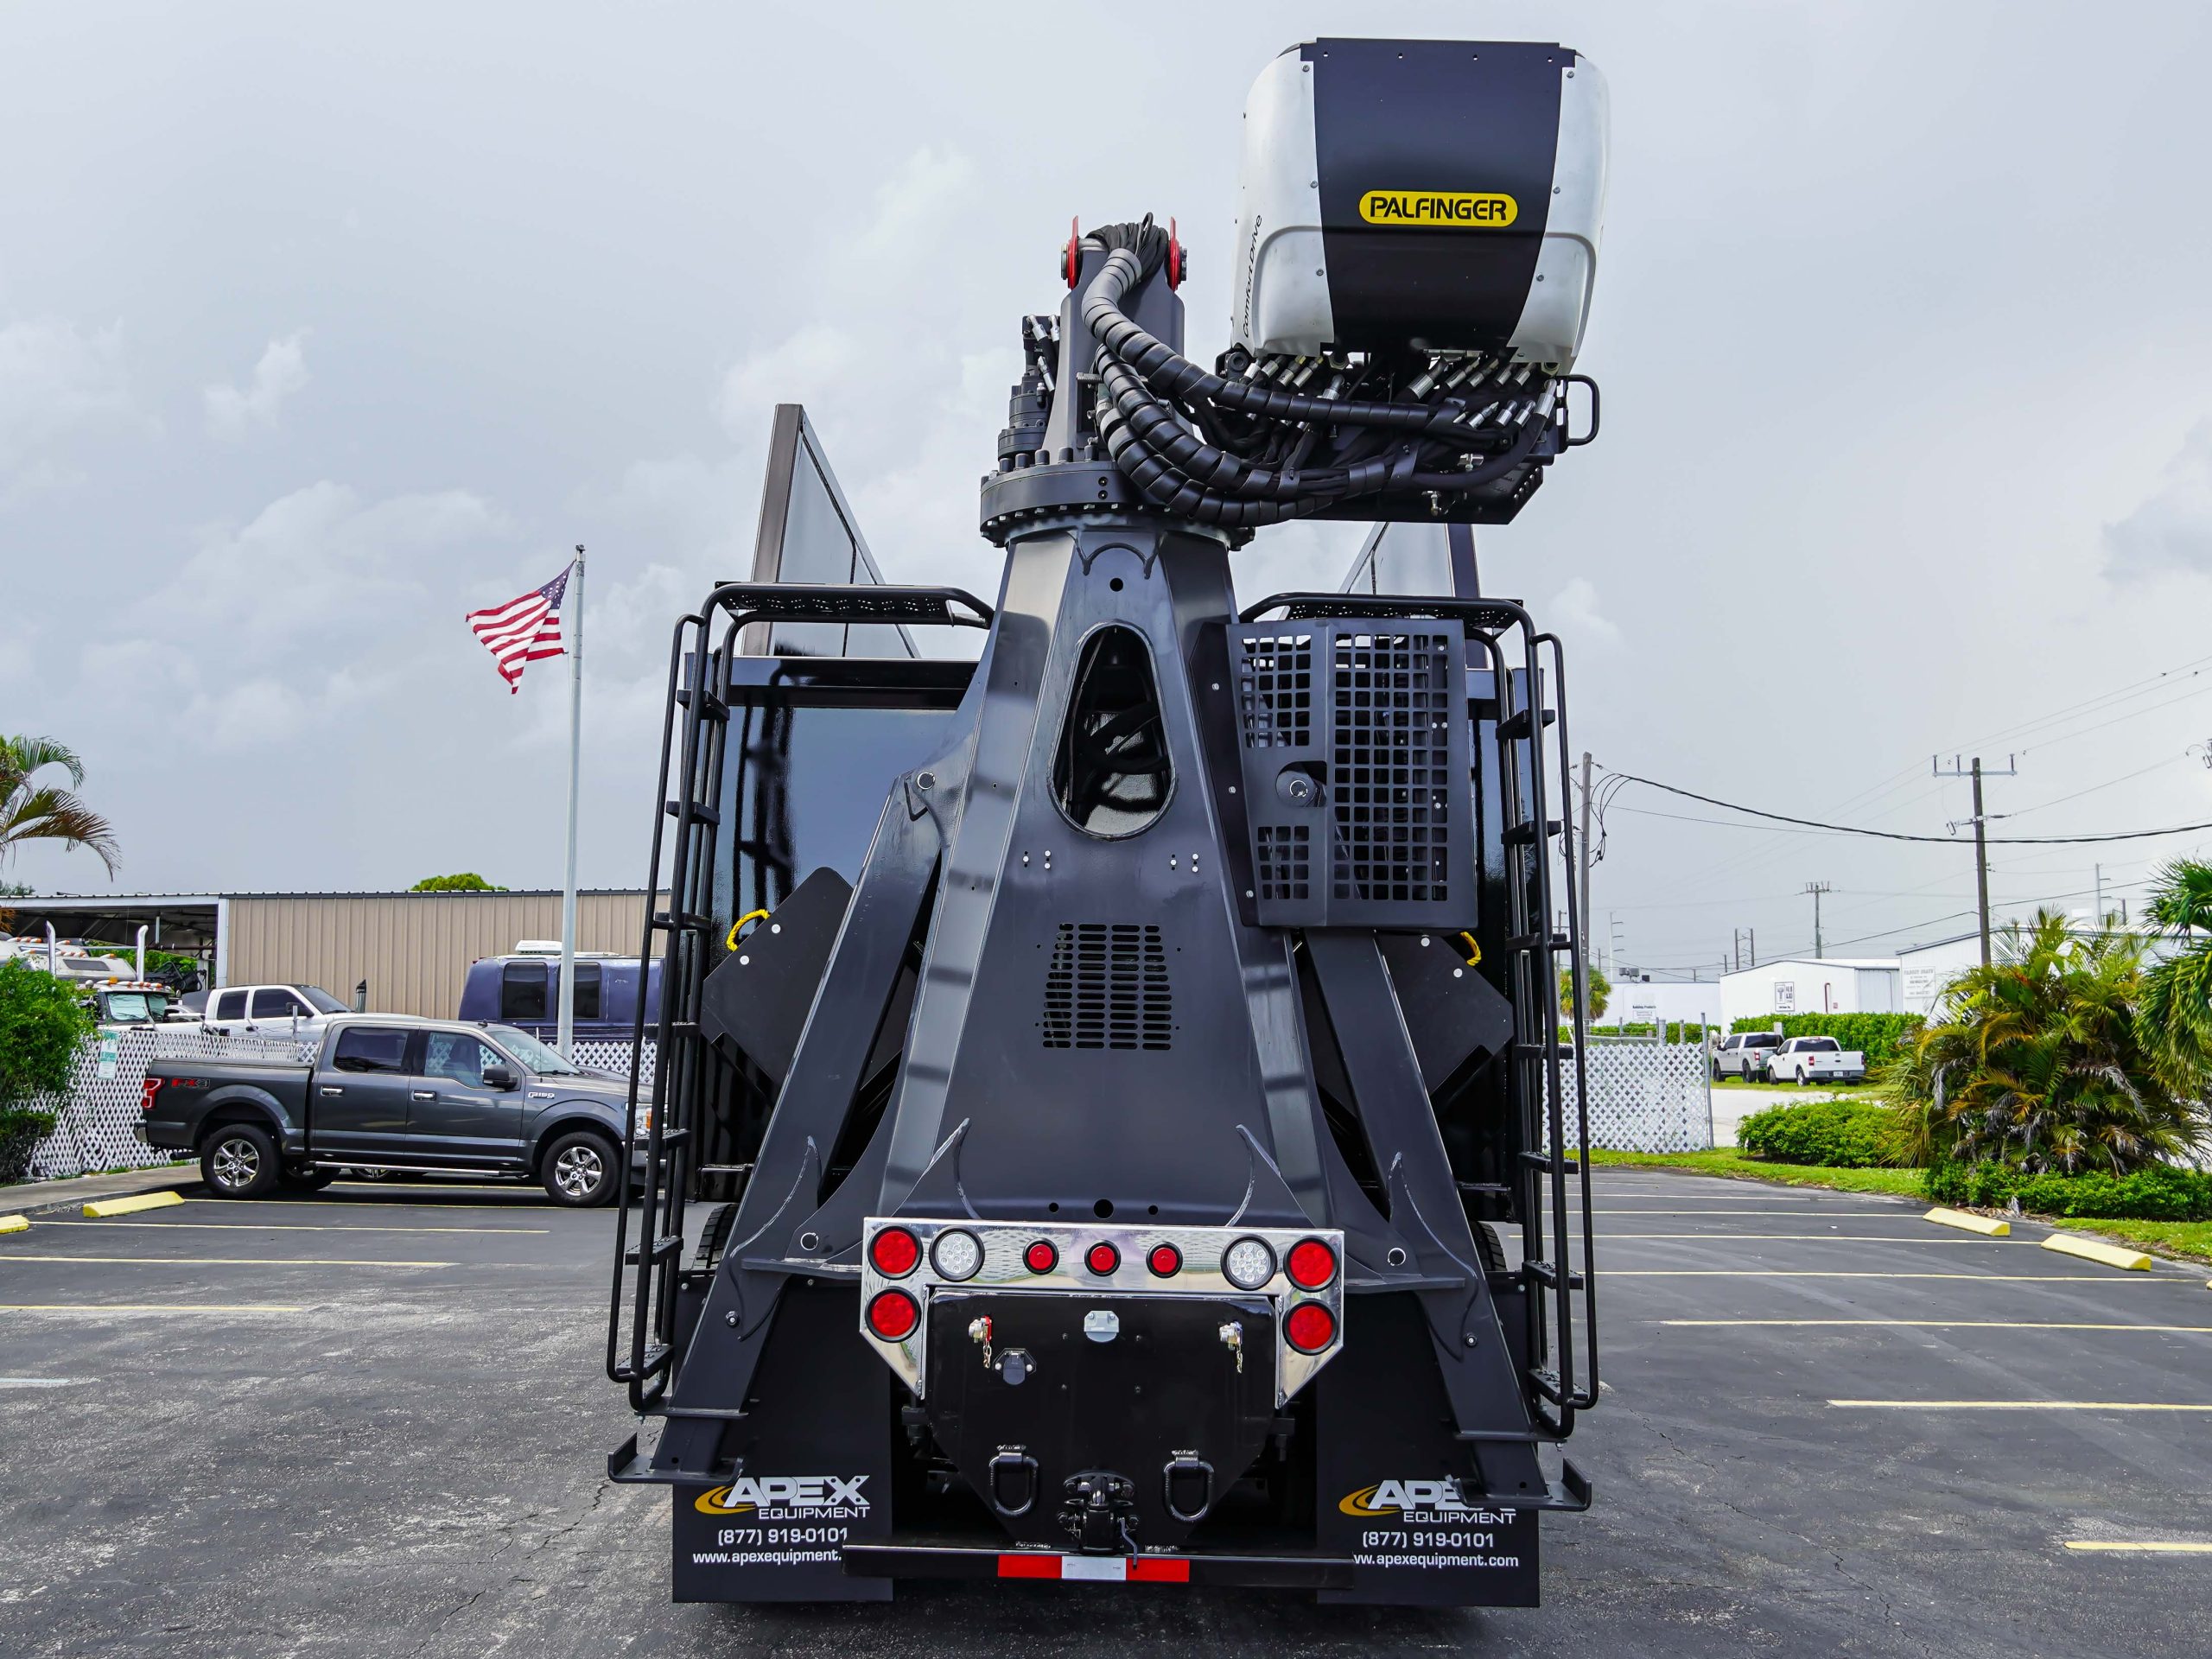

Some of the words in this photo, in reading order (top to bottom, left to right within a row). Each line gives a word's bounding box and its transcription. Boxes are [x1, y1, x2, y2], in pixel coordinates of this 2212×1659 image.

[1370, 195, 1507, 221] PALFINGER
[1243, 266, 1254, 339] Comfort
[1249, 214, 1262, 264] Drive
[723, 1475, 870, 1507] APEX
[1367, 1479, 1516, 1511] APE
[759, 1507, 870, 1520] EQUIPMENT
[1403, 1511, 1516, 1524] EQUIPMENT
[718, 1528, 762, 1547] (877)
[768, 1527, 848, 1544] 919-0101
[1363, 1531, 1408, 1548] (877)
[1413, 1532, 1495, 1548] 919-0101
[693, 1548, 842, 1566] www.apexequipment.
